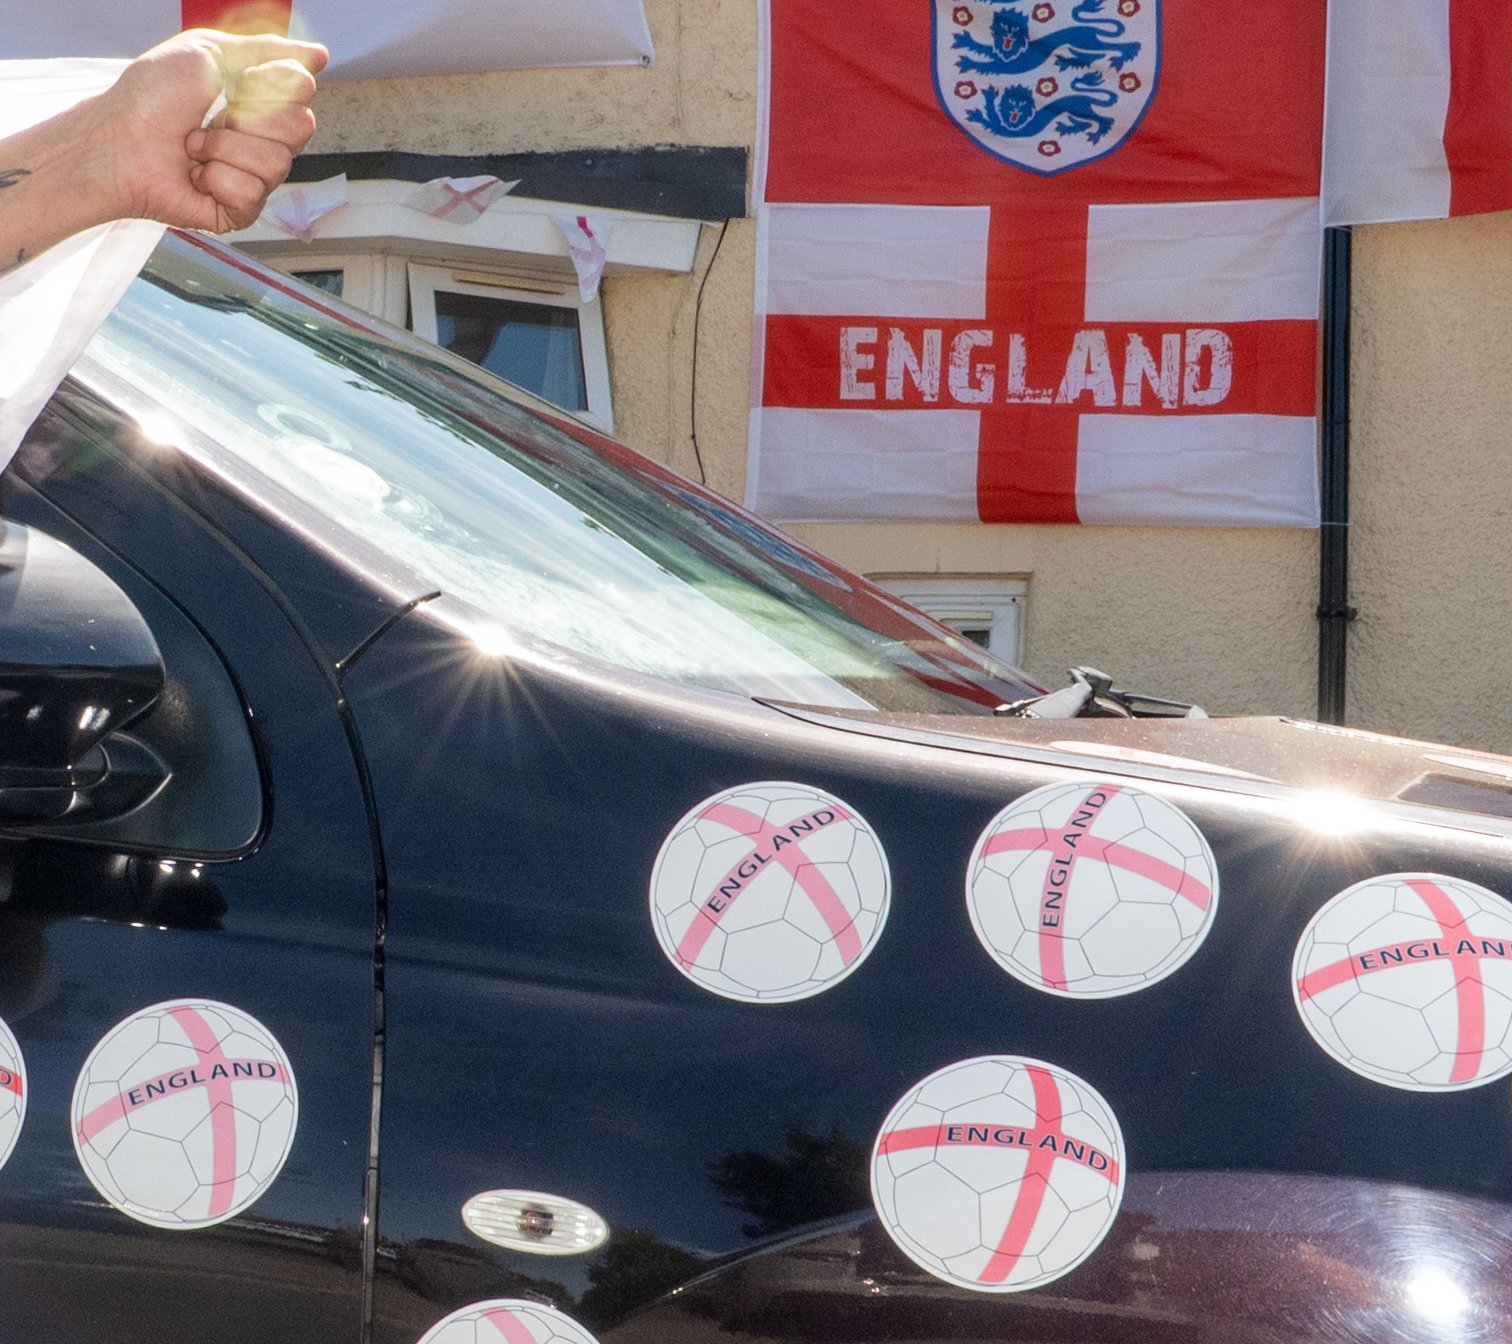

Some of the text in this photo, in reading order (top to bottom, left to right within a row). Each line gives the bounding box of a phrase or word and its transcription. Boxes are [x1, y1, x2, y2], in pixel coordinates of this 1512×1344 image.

[838, 326, 1233, 408] ENGLAND
[706, 808, 835, 915] ENGLAND
[1042, 791, 1107, 928] ENGLAND
[128, 1059, 278, 1106] ENGLAND
[946, 1124, 1109, 1173] ENGLAND
